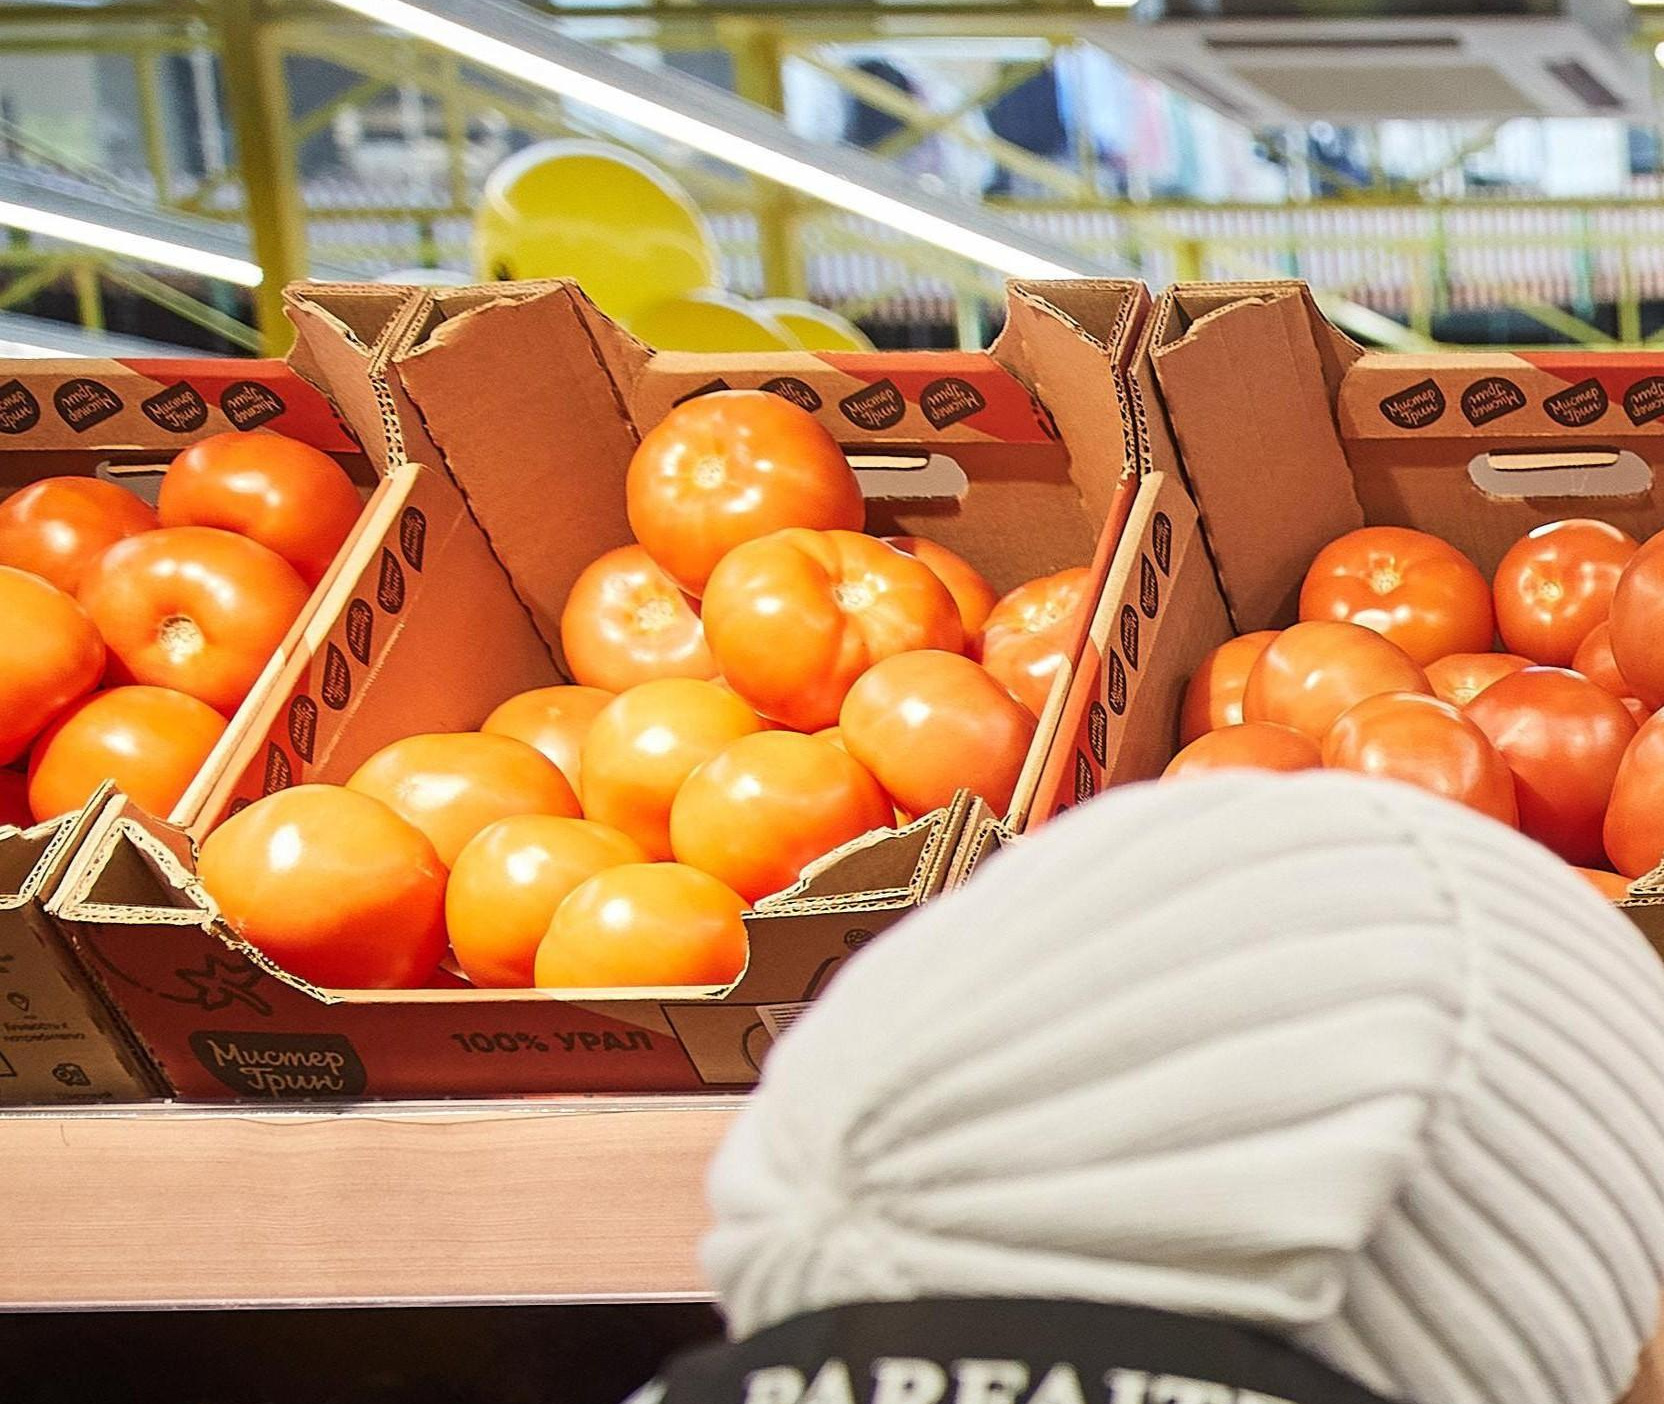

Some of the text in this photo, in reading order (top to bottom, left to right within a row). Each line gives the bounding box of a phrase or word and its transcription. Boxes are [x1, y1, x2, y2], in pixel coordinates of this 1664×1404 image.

[147, 391, 198, 420] Мистер
[844, 390, 895, 418] Мистер
[861, 404, 899, 426] Грин
[1386, 390, 1436, 418] Мистер
[1401, 404, 1439, 425] Грин
[1549, 388, 1599, 416] Мистер
[1563, 402, 1601, 423] Грин
[165, 405, 201, 428] Грин
[450, 1031, 654, 1053] 100% УРАЛ
[210, 1040, 345, 1075] Мистер
[245, 1067, 344, 1099] Грин
